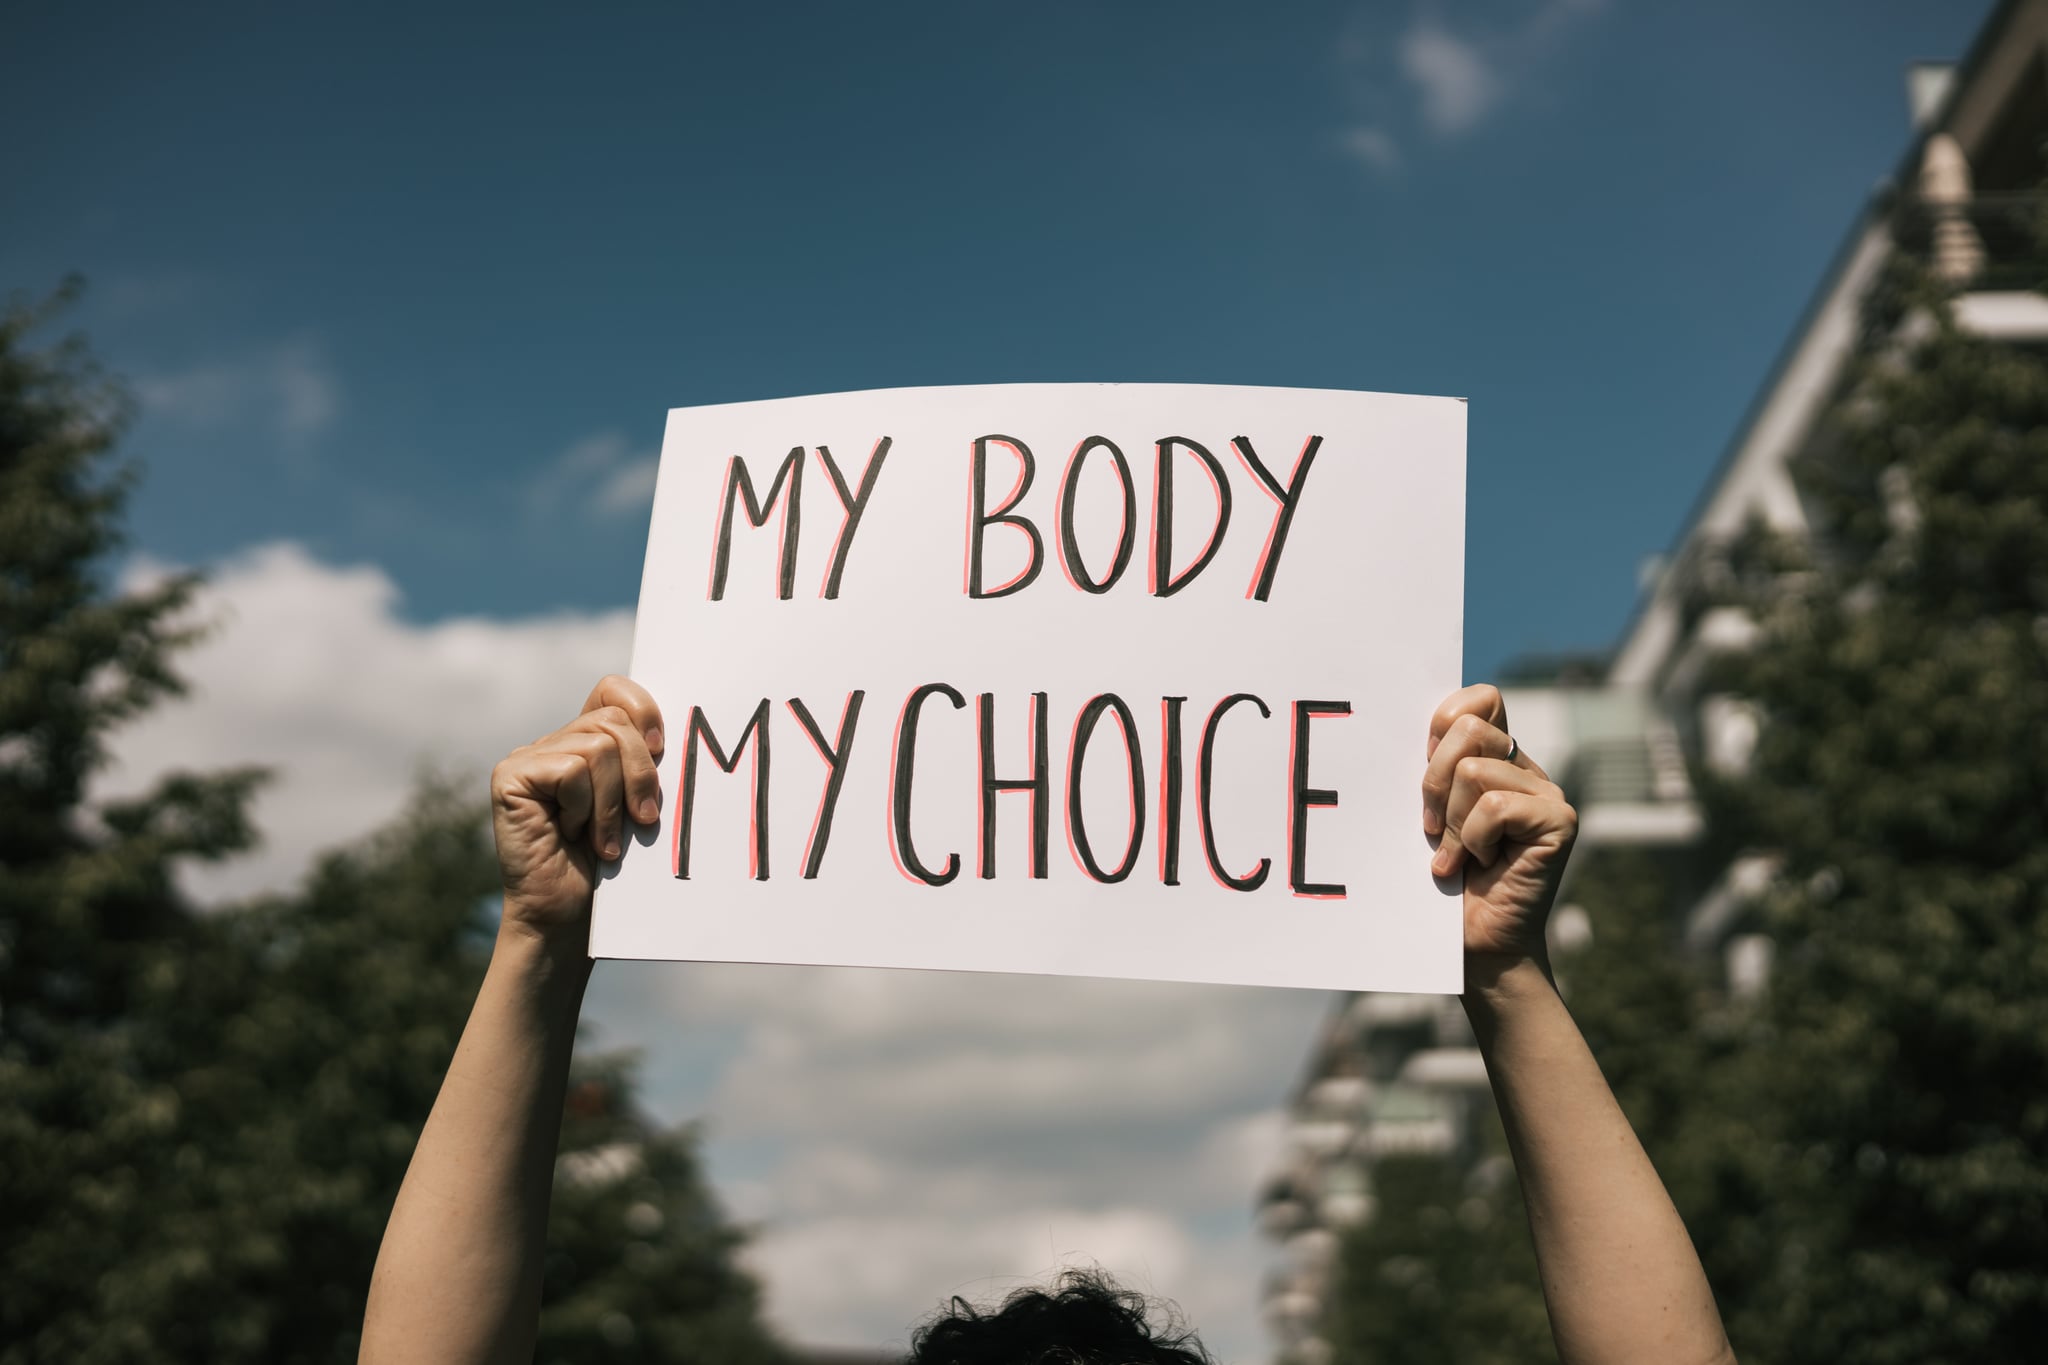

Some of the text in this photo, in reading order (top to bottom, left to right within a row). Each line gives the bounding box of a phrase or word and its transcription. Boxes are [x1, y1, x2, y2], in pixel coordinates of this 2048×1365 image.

[709, 434, 1323, 602] MY BODY
[672, 683, 1353, 899] MY CHOICE
